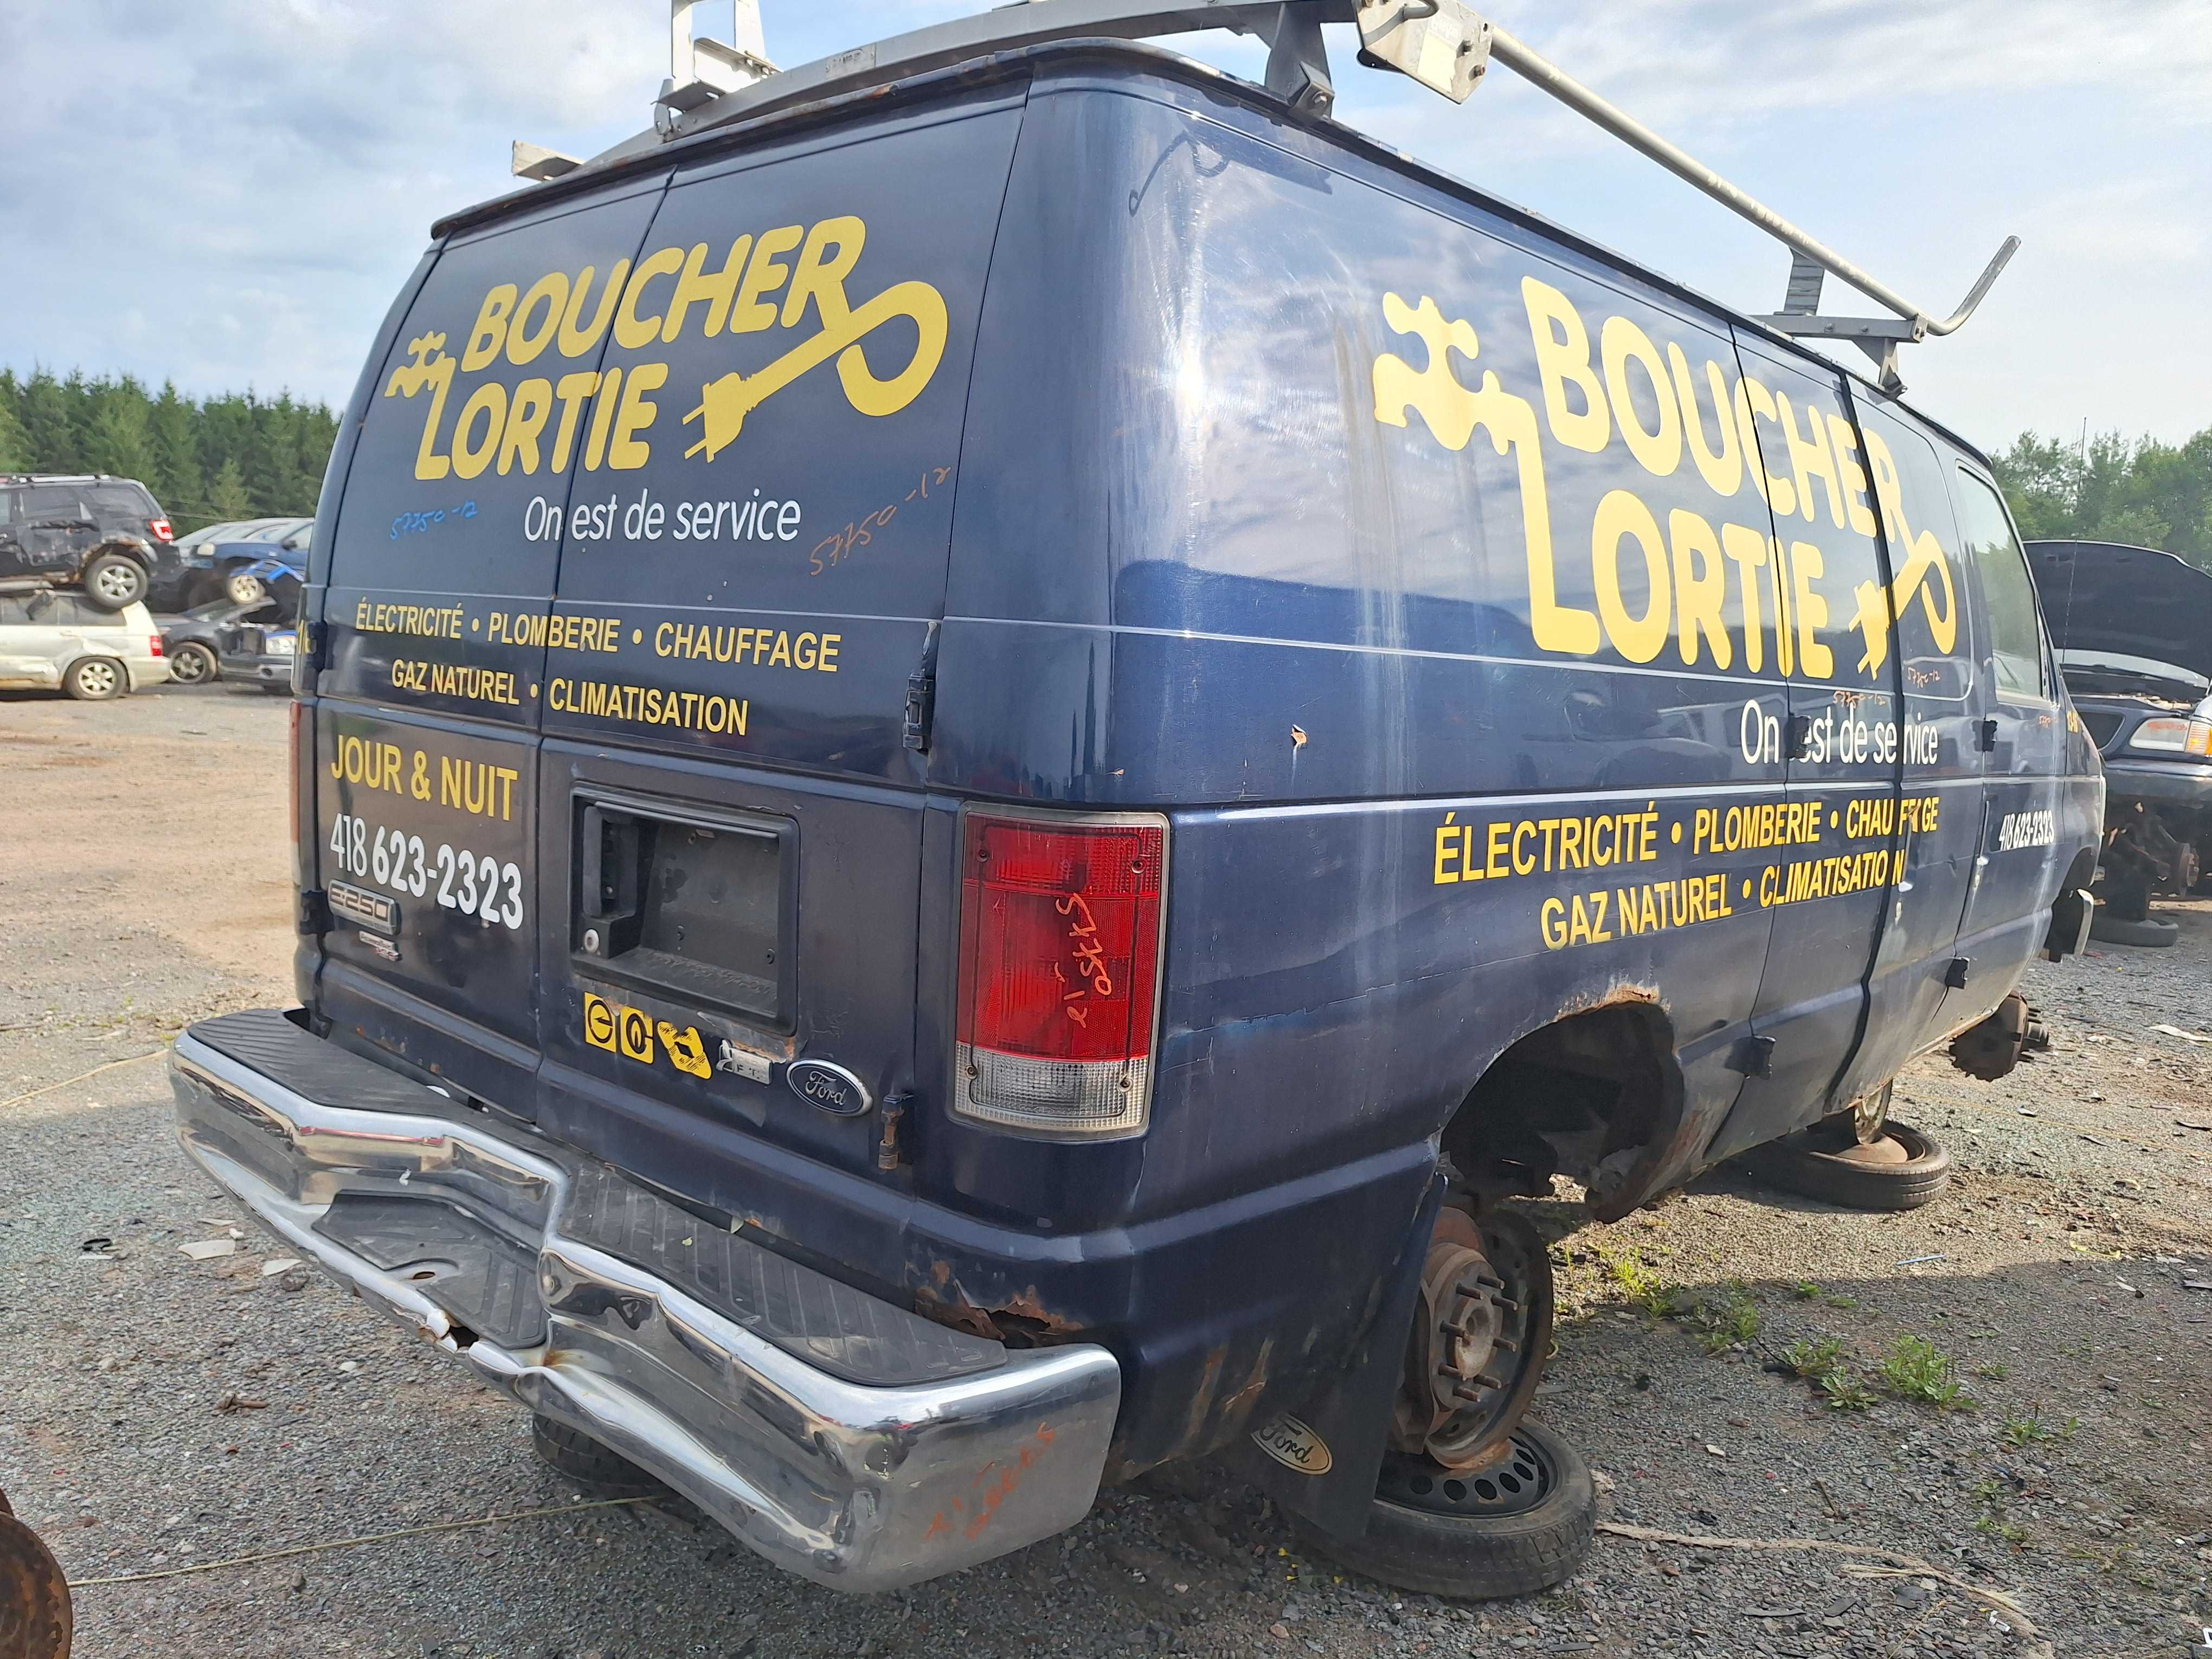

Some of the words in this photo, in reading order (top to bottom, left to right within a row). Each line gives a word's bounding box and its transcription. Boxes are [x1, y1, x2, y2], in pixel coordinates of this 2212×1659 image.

[461, 215, 865, 372] BOUCHER
[414, 357, 668, 480] LORTIE
[1521, 275, 1911, 543] BOUCHER
[524, 496, 562, 541] On
[571, 494, 618, 540] est
[624, 488, 665, 540] de
[673, 488, 801, 541] service
[1515, 395, 1834, 680] LORTIE
[356, 596, 464, 640] ÉLECTRICITÉ
[488, 613, 620, 652] PLOMBERIE
[655, 622, 841, 672] CHAUFFAGE
[391, 659, 428, 691] GAZ
[430, 666, 519, 705] NATUREL
[549, 678, 748, 736] CLIMATISATION
[1741, 699, 1779, 764] On
[1840, 702, 1868, 764] de
[1873, 711, 1939, 765] service
[330, 736, 404, 795] JOUR
[410, 750, 433, 802] &
[439, 757, 519, 821] NUIT
[330, 813, 368, 877] 418
[372, 825, 523, 930] 623-2323
[1433, 800, 1659, 885] ÉLECTRICITÉ
[1693, 801, 1822, 856] PLOMBERIE
[1998, 814, 2015, 851] 418
[2013, 808, 2056, 849] 623-2323
[1541, 889, 1612, 949] GAZ
[1617, 873, 1733, 935] NATUREL
[1759, 849, 1906, 909] CLIMATISATION
[1259, 1416, 1315, 1464] Ford
